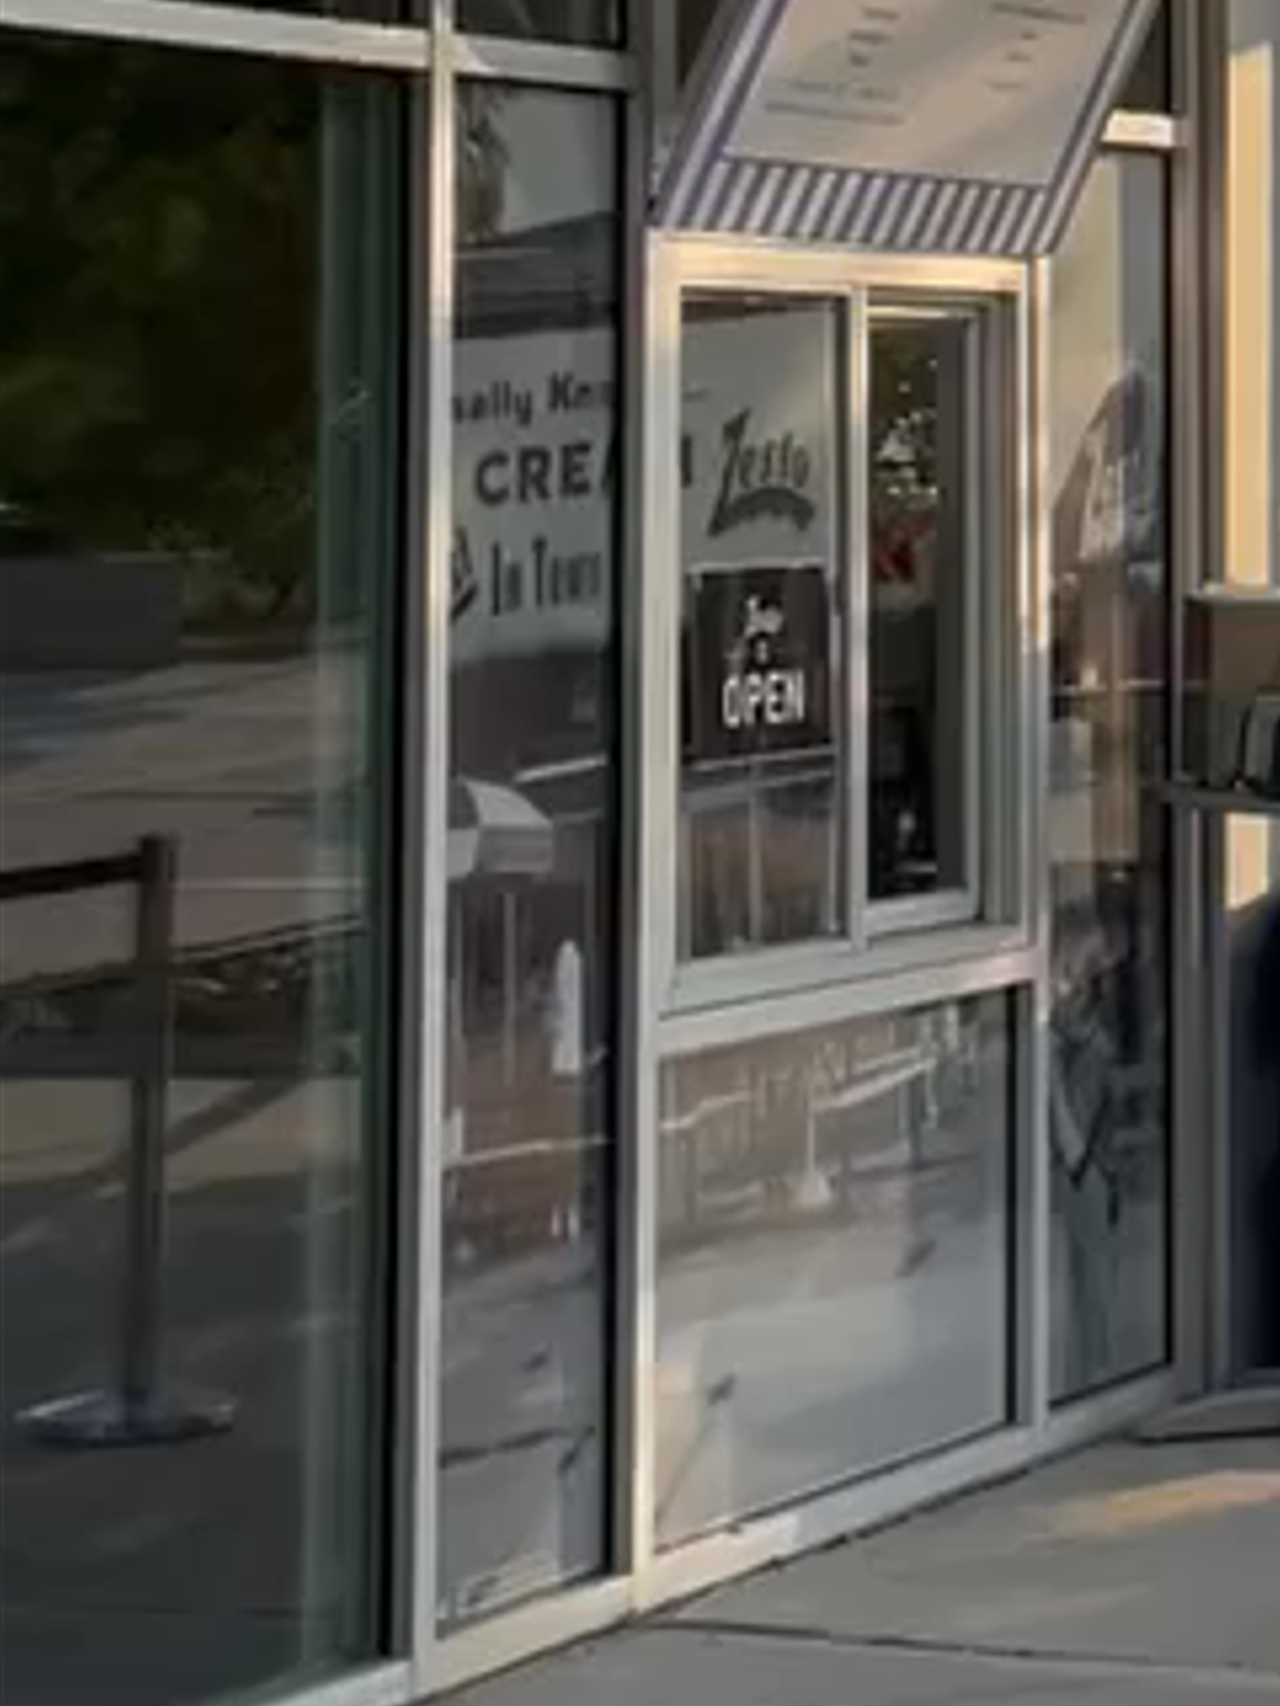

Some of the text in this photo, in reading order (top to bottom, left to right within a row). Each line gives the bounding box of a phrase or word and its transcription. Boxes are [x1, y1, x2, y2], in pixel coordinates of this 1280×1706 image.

[474, 431, 692, 506] CRE
[706, 406, 818, 538] Zesto
[721, 669, 806, 730] OPEN
